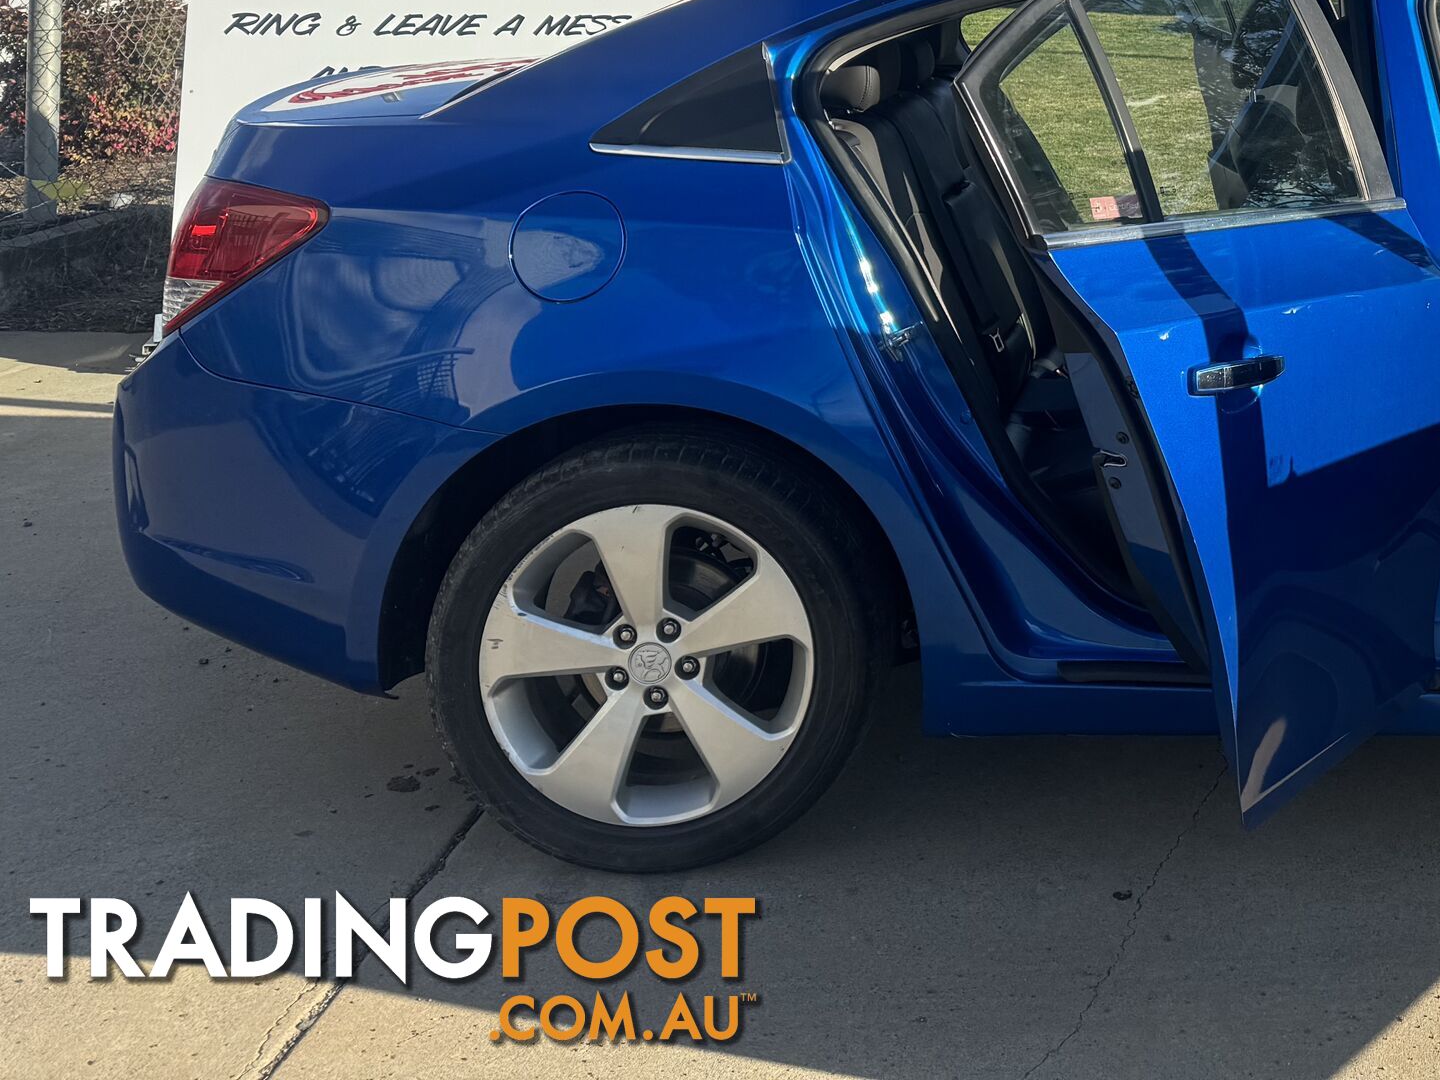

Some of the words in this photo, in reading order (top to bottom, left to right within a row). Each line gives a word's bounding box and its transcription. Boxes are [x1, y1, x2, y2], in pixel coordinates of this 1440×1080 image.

[223, 12, 322, 37] RING
[335, 15, 363, 37] &
[372, 14, 488, 37] LEAVE
[493, 15, 525, 37] A
